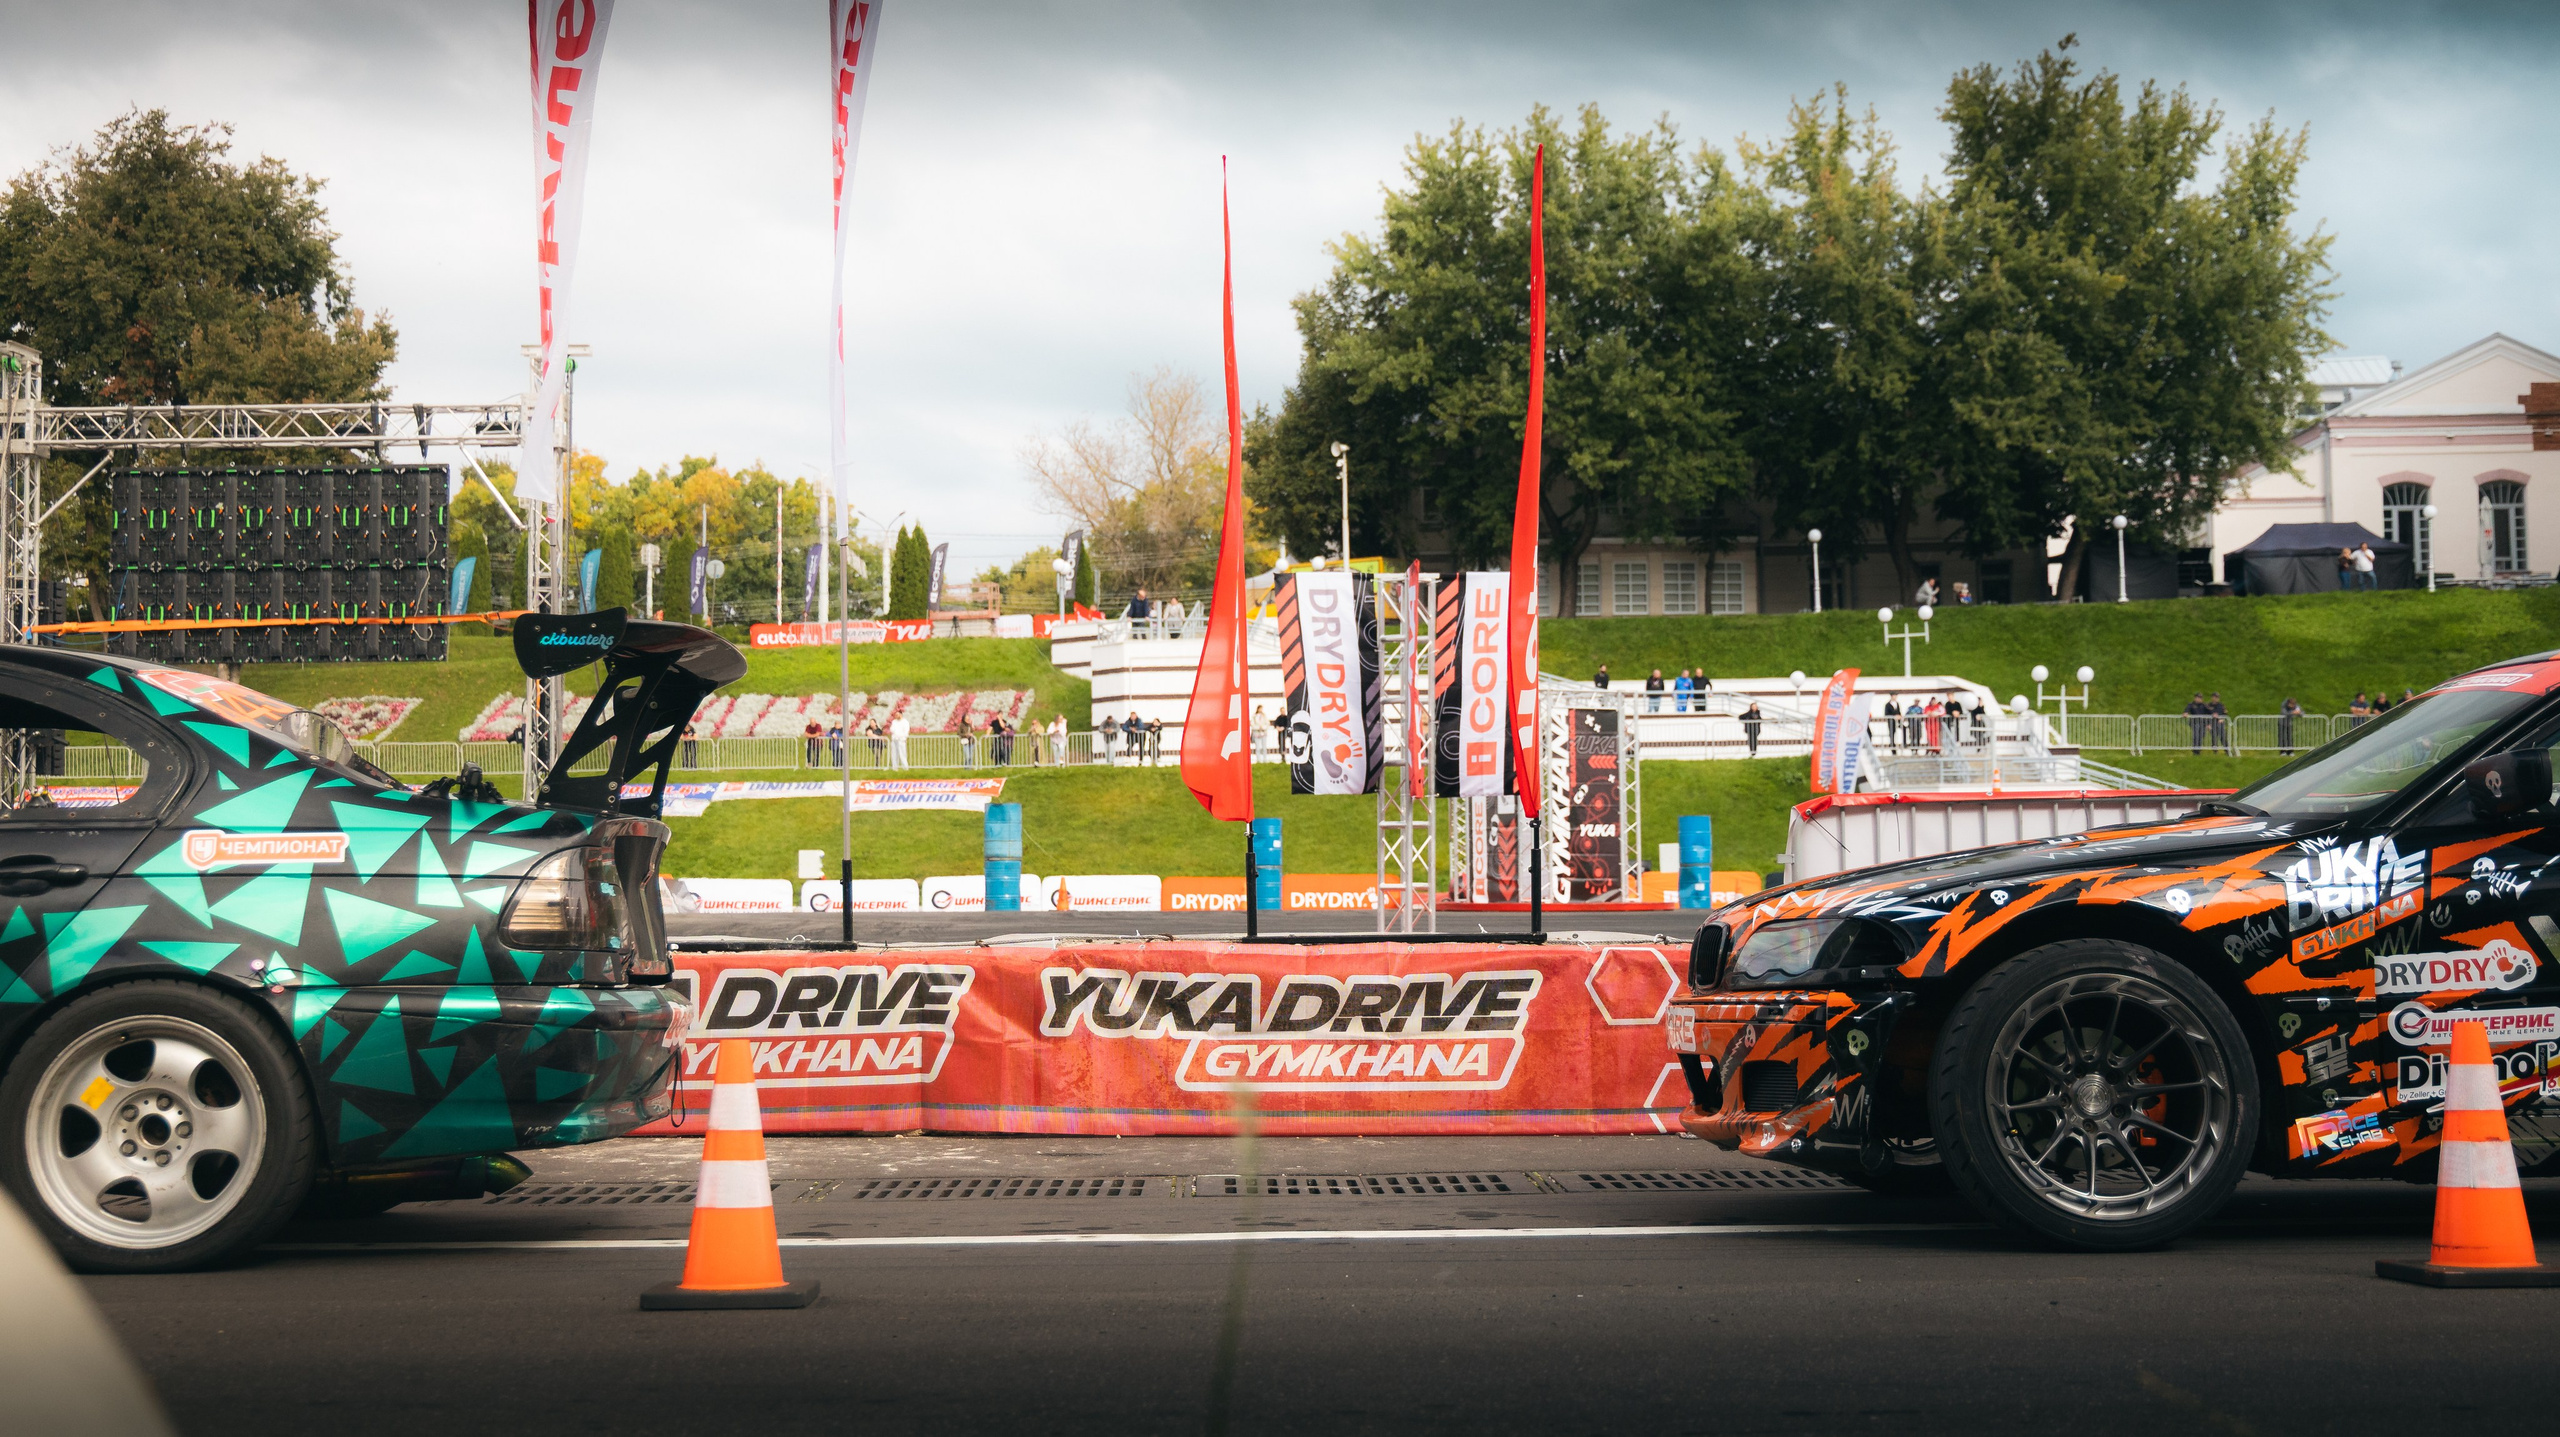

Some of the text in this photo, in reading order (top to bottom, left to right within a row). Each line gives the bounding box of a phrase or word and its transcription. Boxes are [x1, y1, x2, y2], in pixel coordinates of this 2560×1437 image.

[1308, 588, 1351, 738] DRYDRY
[879, 794, 958, 804] DINITROL
[1551, 709, 1571, 904] GYMKHANA
[1579, 823, 1617, 838] YUKA
[220, 839, 342, 855] ЧЕМПИОНАТ
[1290, 891, 1366, 908] DRYDRY
[2288, 850, 2426, 933] DRIVE
[704, 900, 782, 910] ШИНСЕРВИС
[833, 900, 908, 910] ШНСЕРВИС
[1074, 896, 1152, 906] ШИНСЕРВИС
[706, 972, 966, 1030] DRIVE
[1048, 975, 1535, 1033] YUKA DRIVE
[2516, 1027, 2555, 1036] ЦЕНТРЫ
[1205, 1043, 1489, 1078] GYMKHANA
[2399, 1092, 2408, 1100] by
[2409, 1090, 2430, 1098] Zeller
